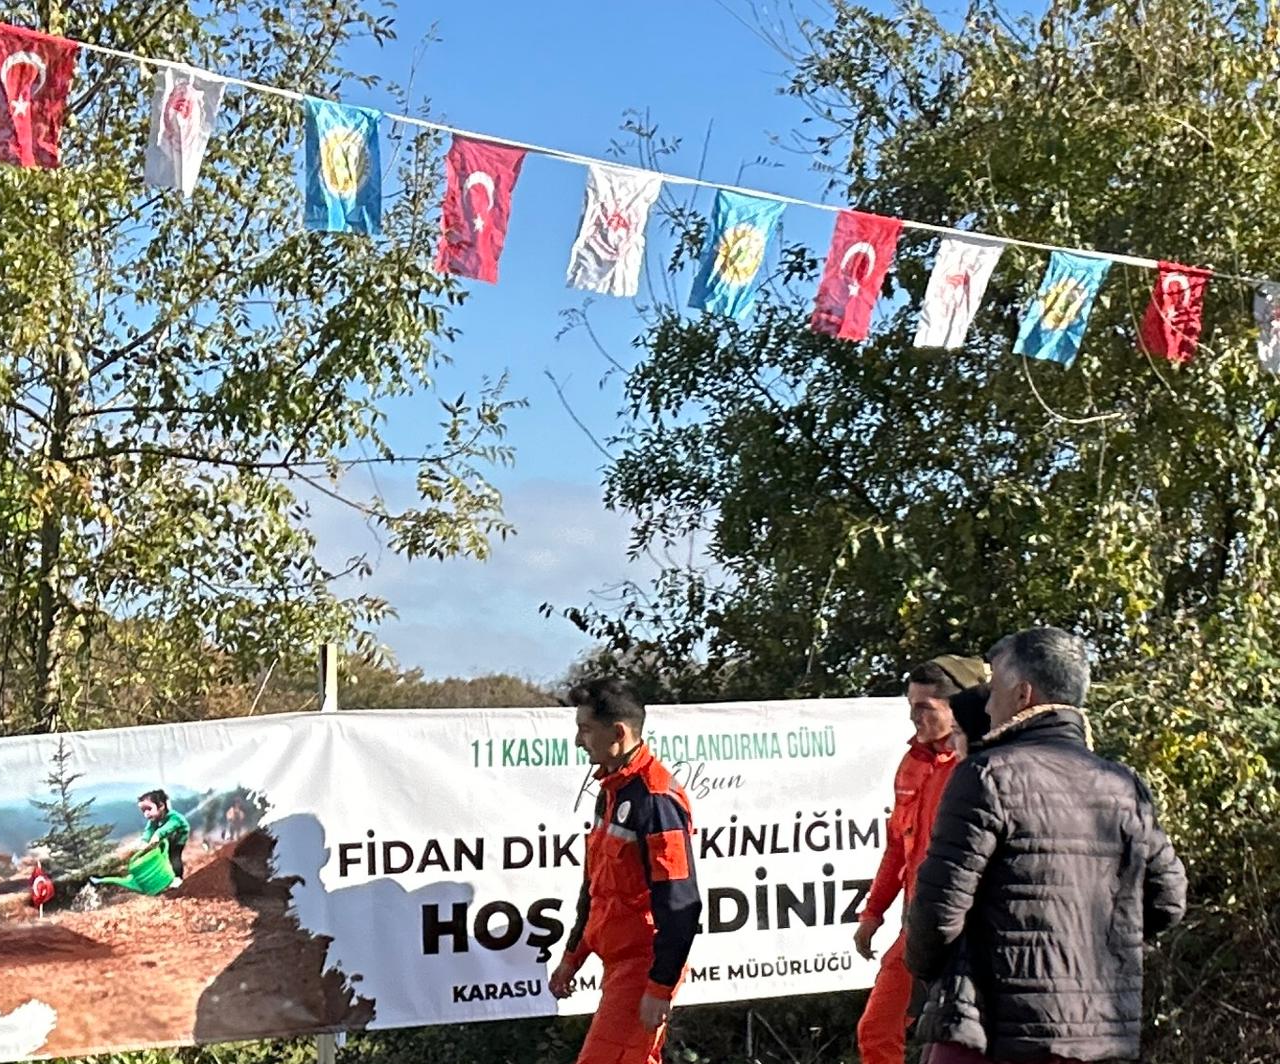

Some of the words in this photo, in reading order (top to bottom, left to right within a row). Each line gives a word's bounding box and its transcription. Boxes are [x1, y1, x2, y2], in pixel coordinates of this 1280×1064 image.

[472, 738, 493, 768] 11
[502, 738, 569, 767] KASIM
[647, 730, 782, 765] ĞAÇLANDIRMA
[787, 725, 836, 758] GÜNÜ
[338, 829, 484, 877] FİDAN
[503, 821, 592, 870] DİKİ
[422, 898, 564, 963] HOŞ
[696, 863, 874, 934] DİNİZ
[453, 979, 542, 1003] KARASU
[728, 951, 852, 980] MÜDÜRLÜĞÜ
